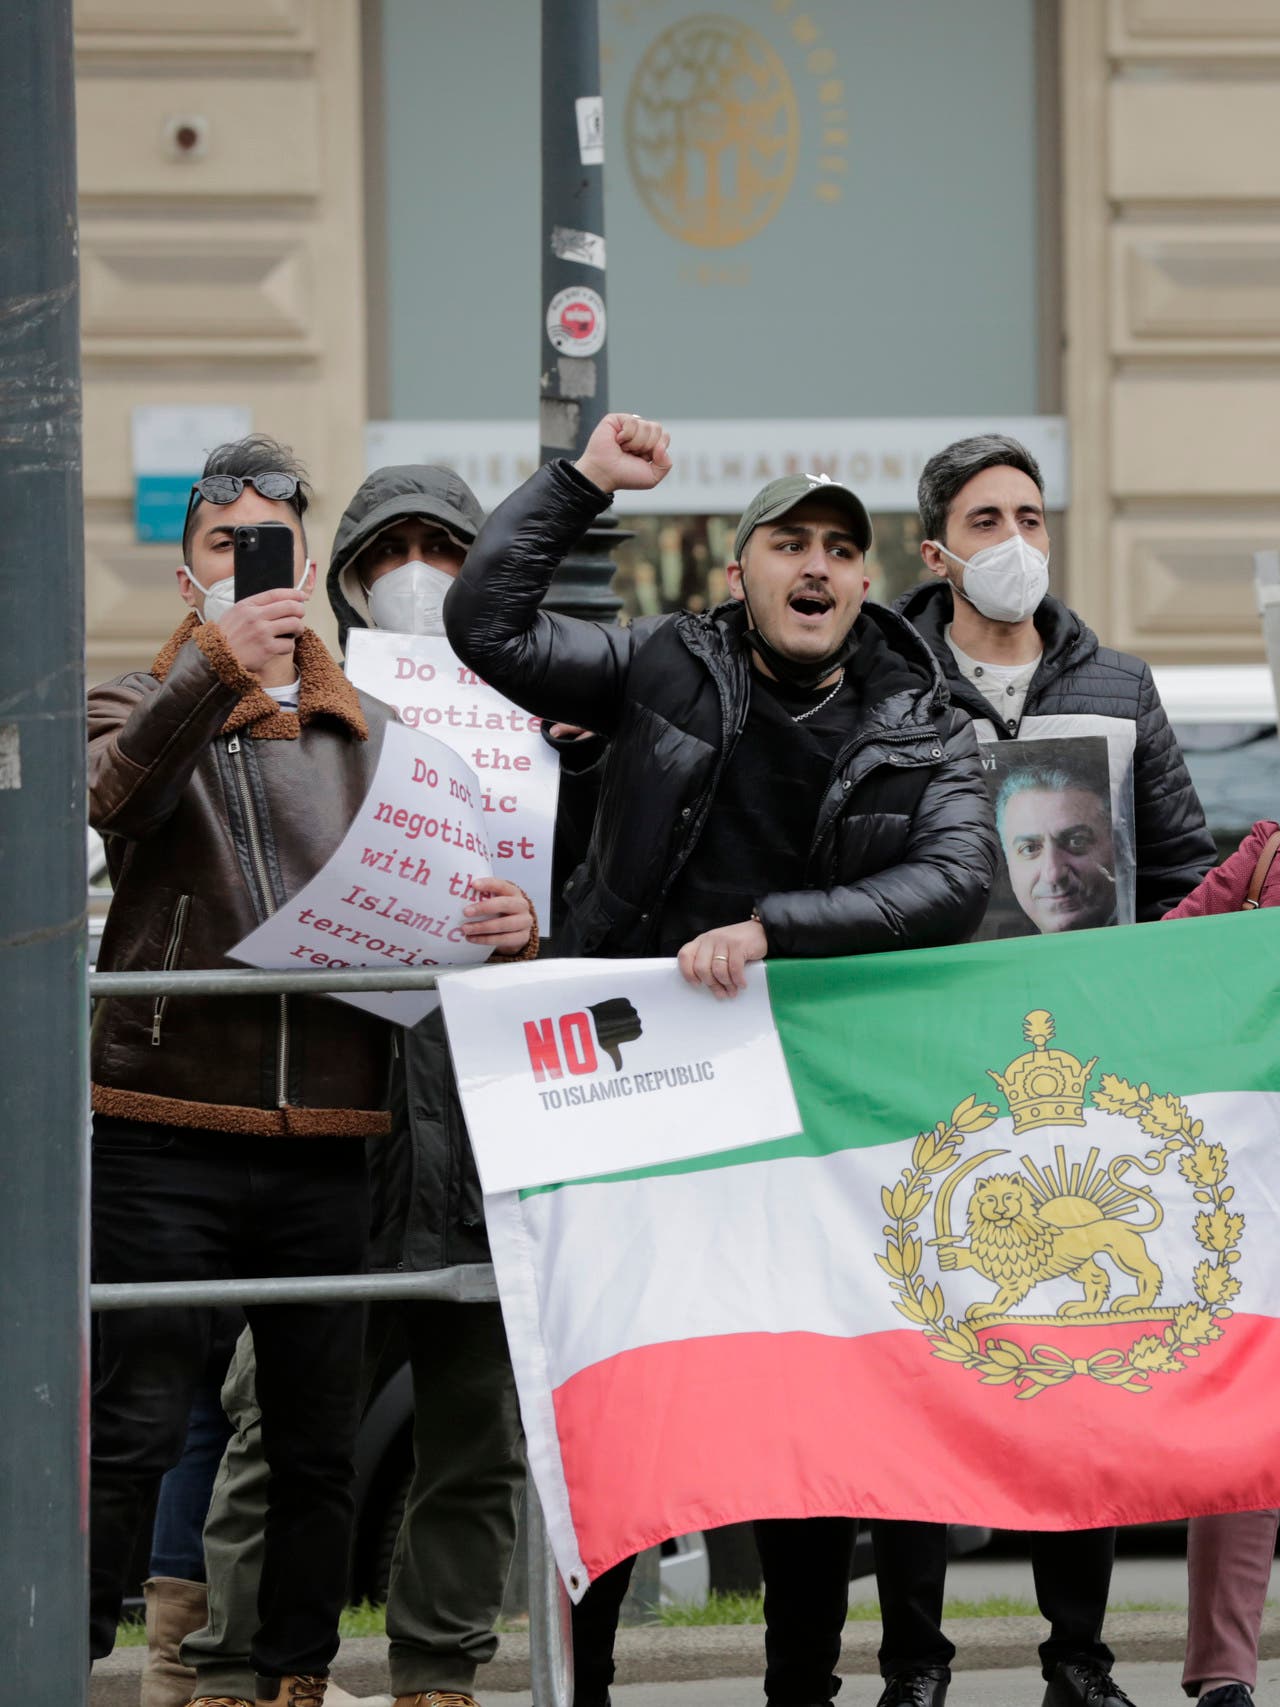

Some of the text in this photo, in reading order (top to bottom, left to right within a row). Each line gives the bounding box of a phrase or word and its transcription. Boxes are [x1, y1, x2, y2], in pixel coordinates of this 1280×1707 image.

[395, 657, 490, 686] Do n
[472, 748, 532, 771] the
[981, 754, 997, 770] vi
[412, 757, 474, 809] Do not
[481, 787, 517, 813] ic
[490, 836, 535, 860] st
[360, 847, 431, 886] with
[341, 885, 465, 943] Islamic
[523, 1011, 599, 1083] NO
[538, 1061, 716, 1111] TO ISLAMIC REPUBLIC
